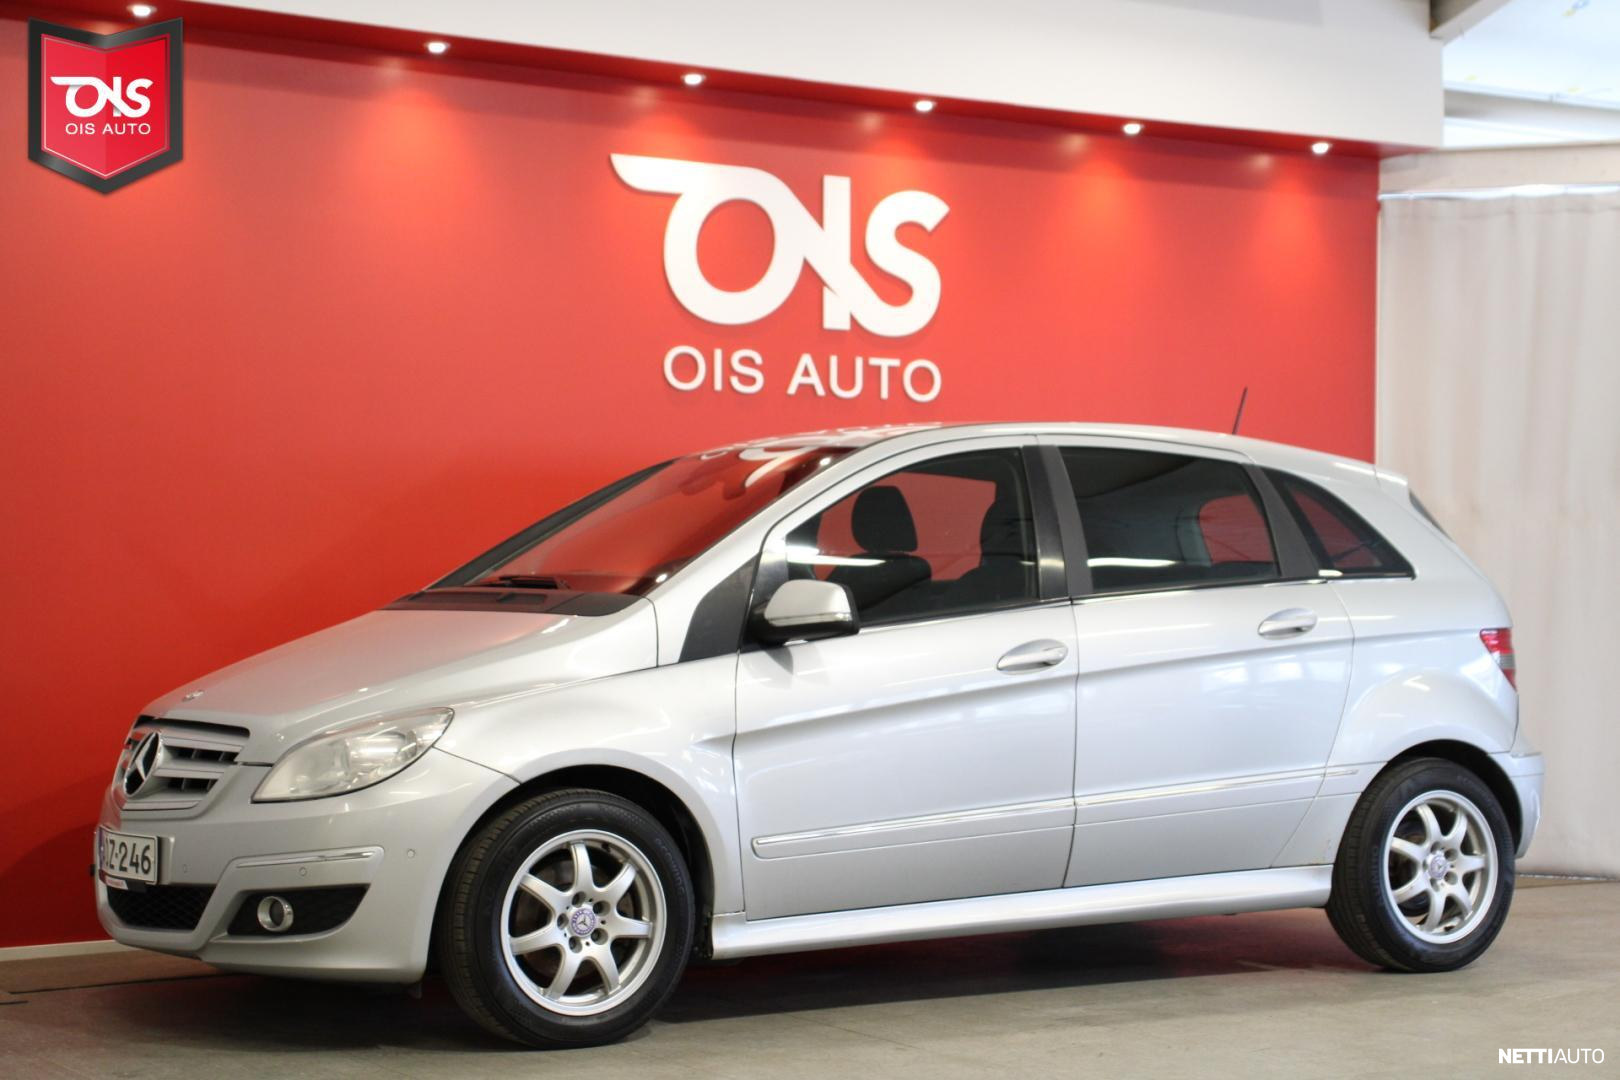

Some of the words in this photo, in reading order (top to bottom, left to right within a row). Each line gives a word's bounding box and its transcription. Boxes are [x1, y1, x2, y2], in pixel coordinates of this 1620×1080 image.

[610, 153, 951, 338] OIS
[663, 345, 765, 395] OIS
[787, 353, 943, 403] AUTO
